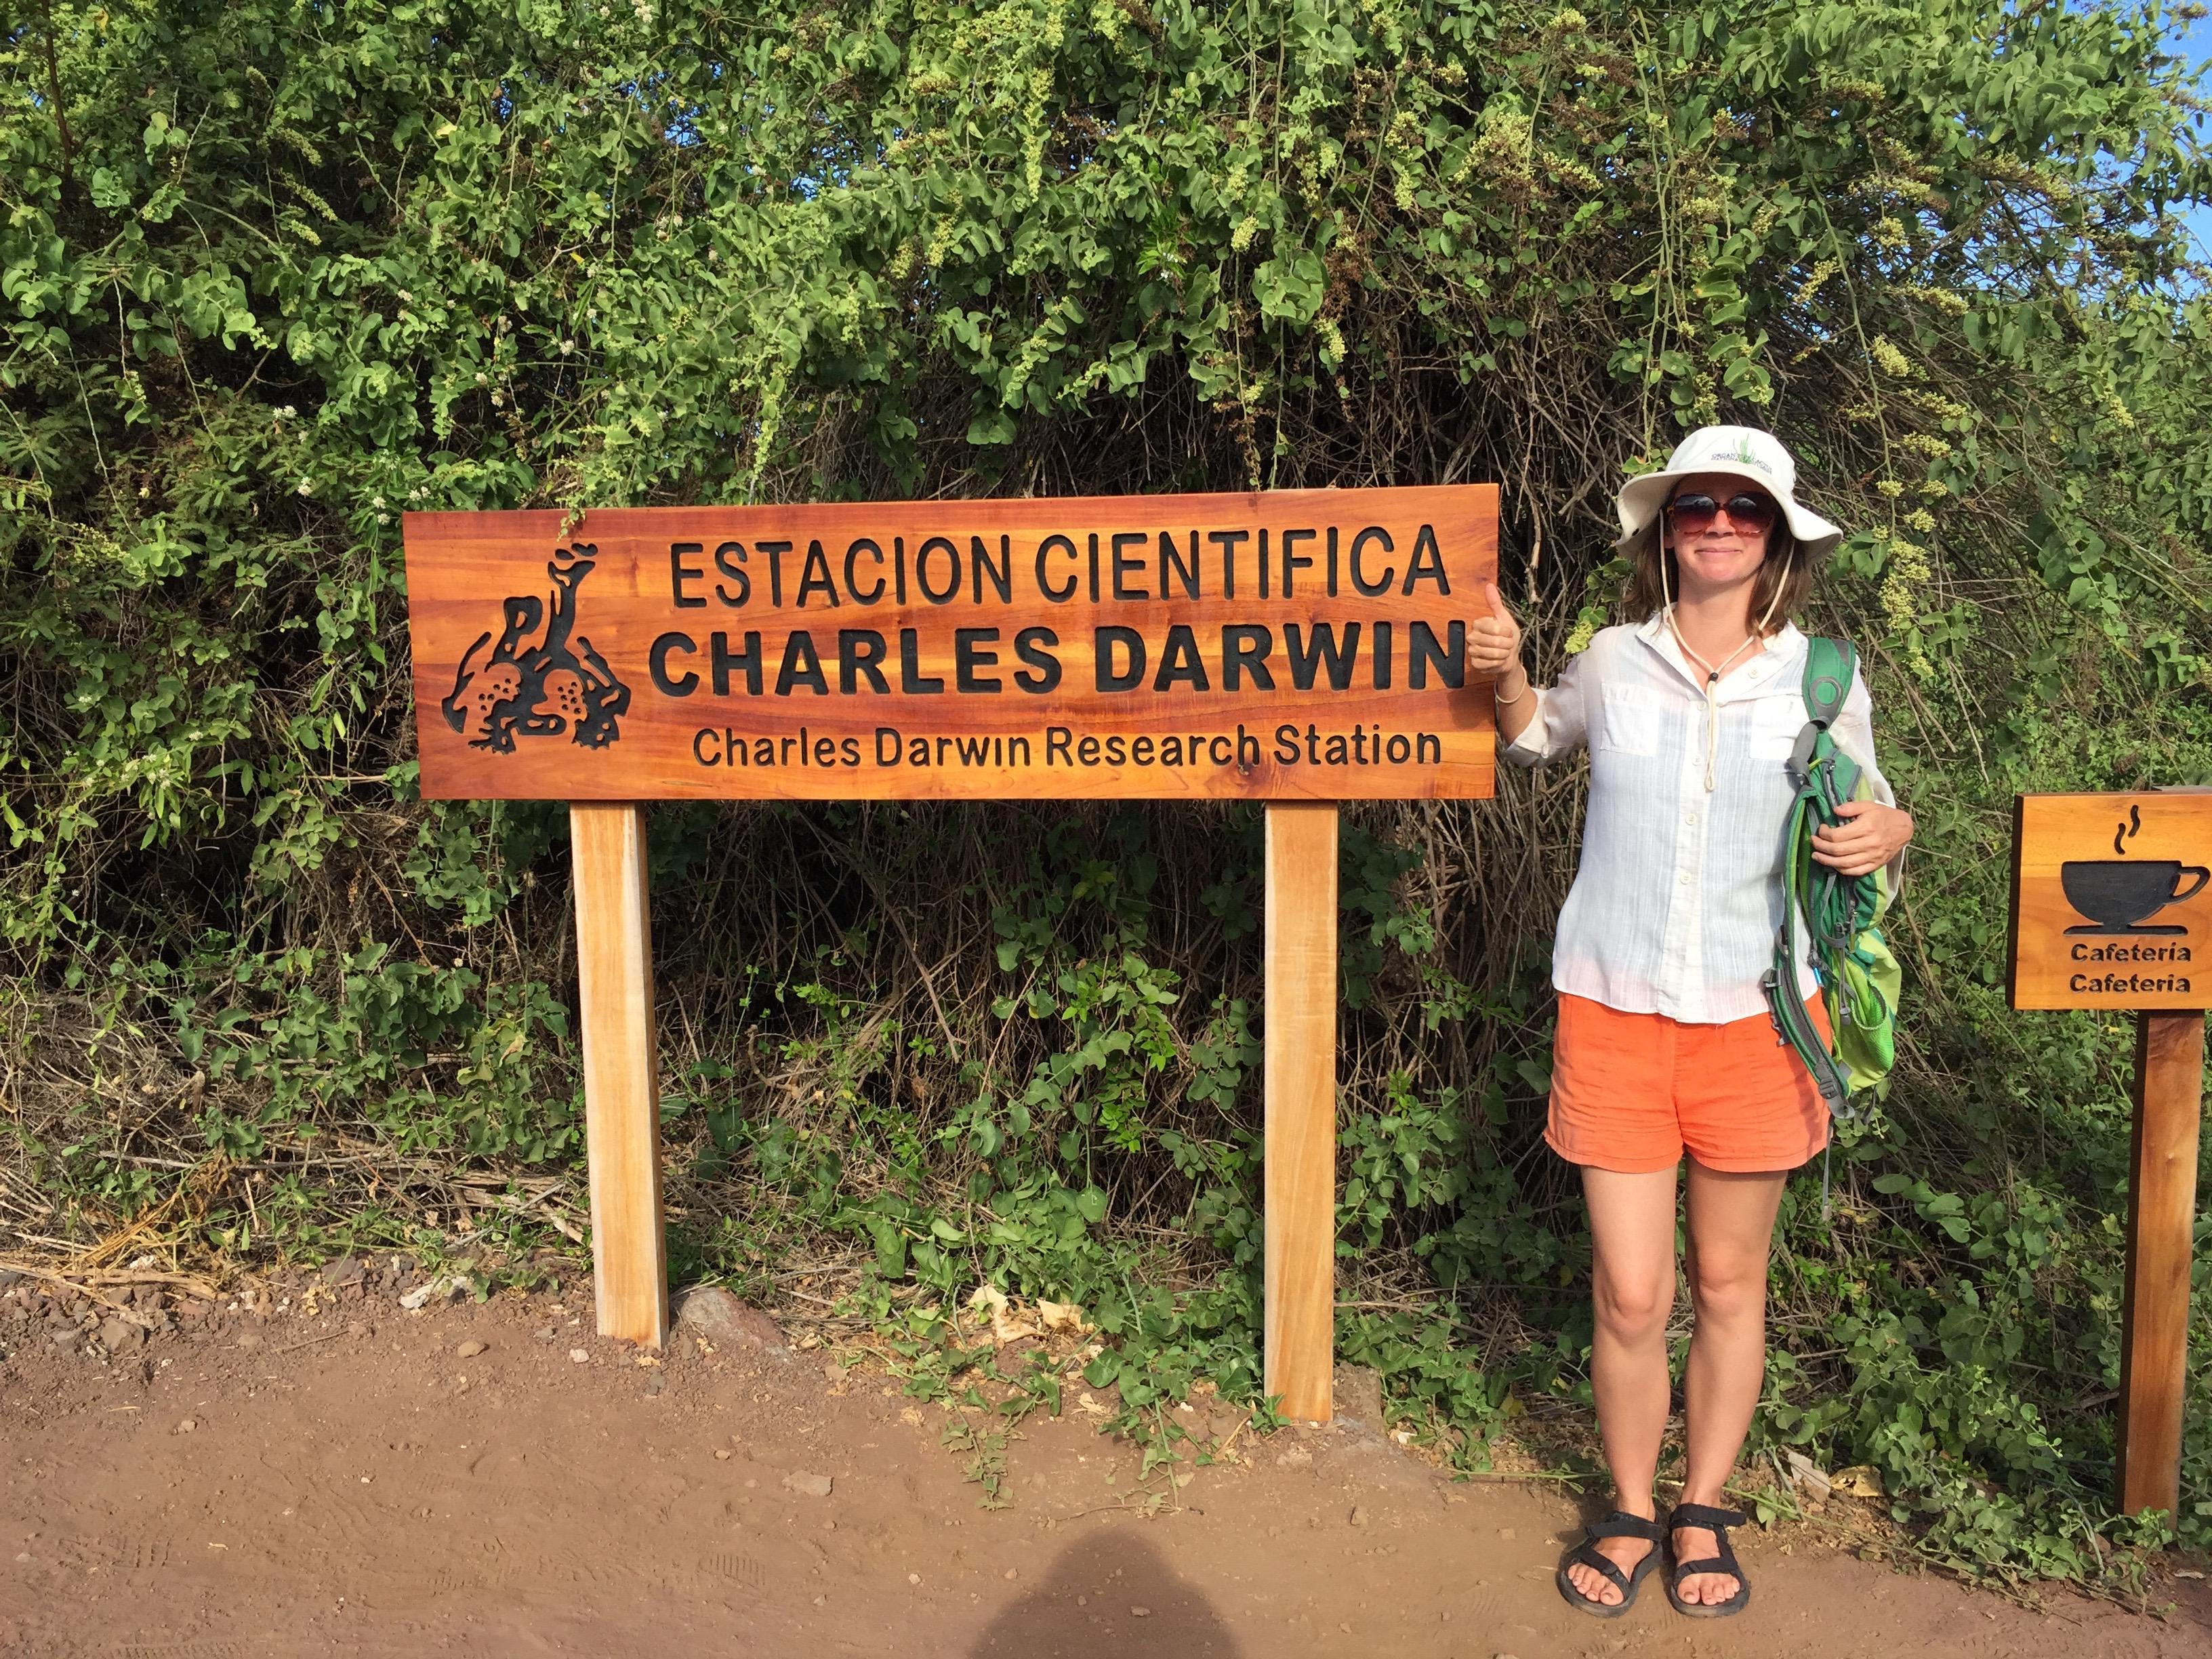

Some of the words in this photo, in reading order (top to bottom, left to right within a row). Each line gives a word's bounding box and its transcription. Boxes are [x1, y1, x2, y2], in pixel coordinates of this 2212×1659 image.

[670, 534, 1012, 609] ESTACION
[1035, 524, 1451, 603] CIENTIFICA
[649, 626, 1062, 697] CHARLES
[1094, 619, 1467, 693] DARWIN
[693, 726, 861, 767] Charles
[875, 727, 1031, 767] Darwin
[1046, 724, 1260, 768] Research
[1273, 724, 1441, 765] Station
[2070, 973, 2190, 994] Cafeteria
